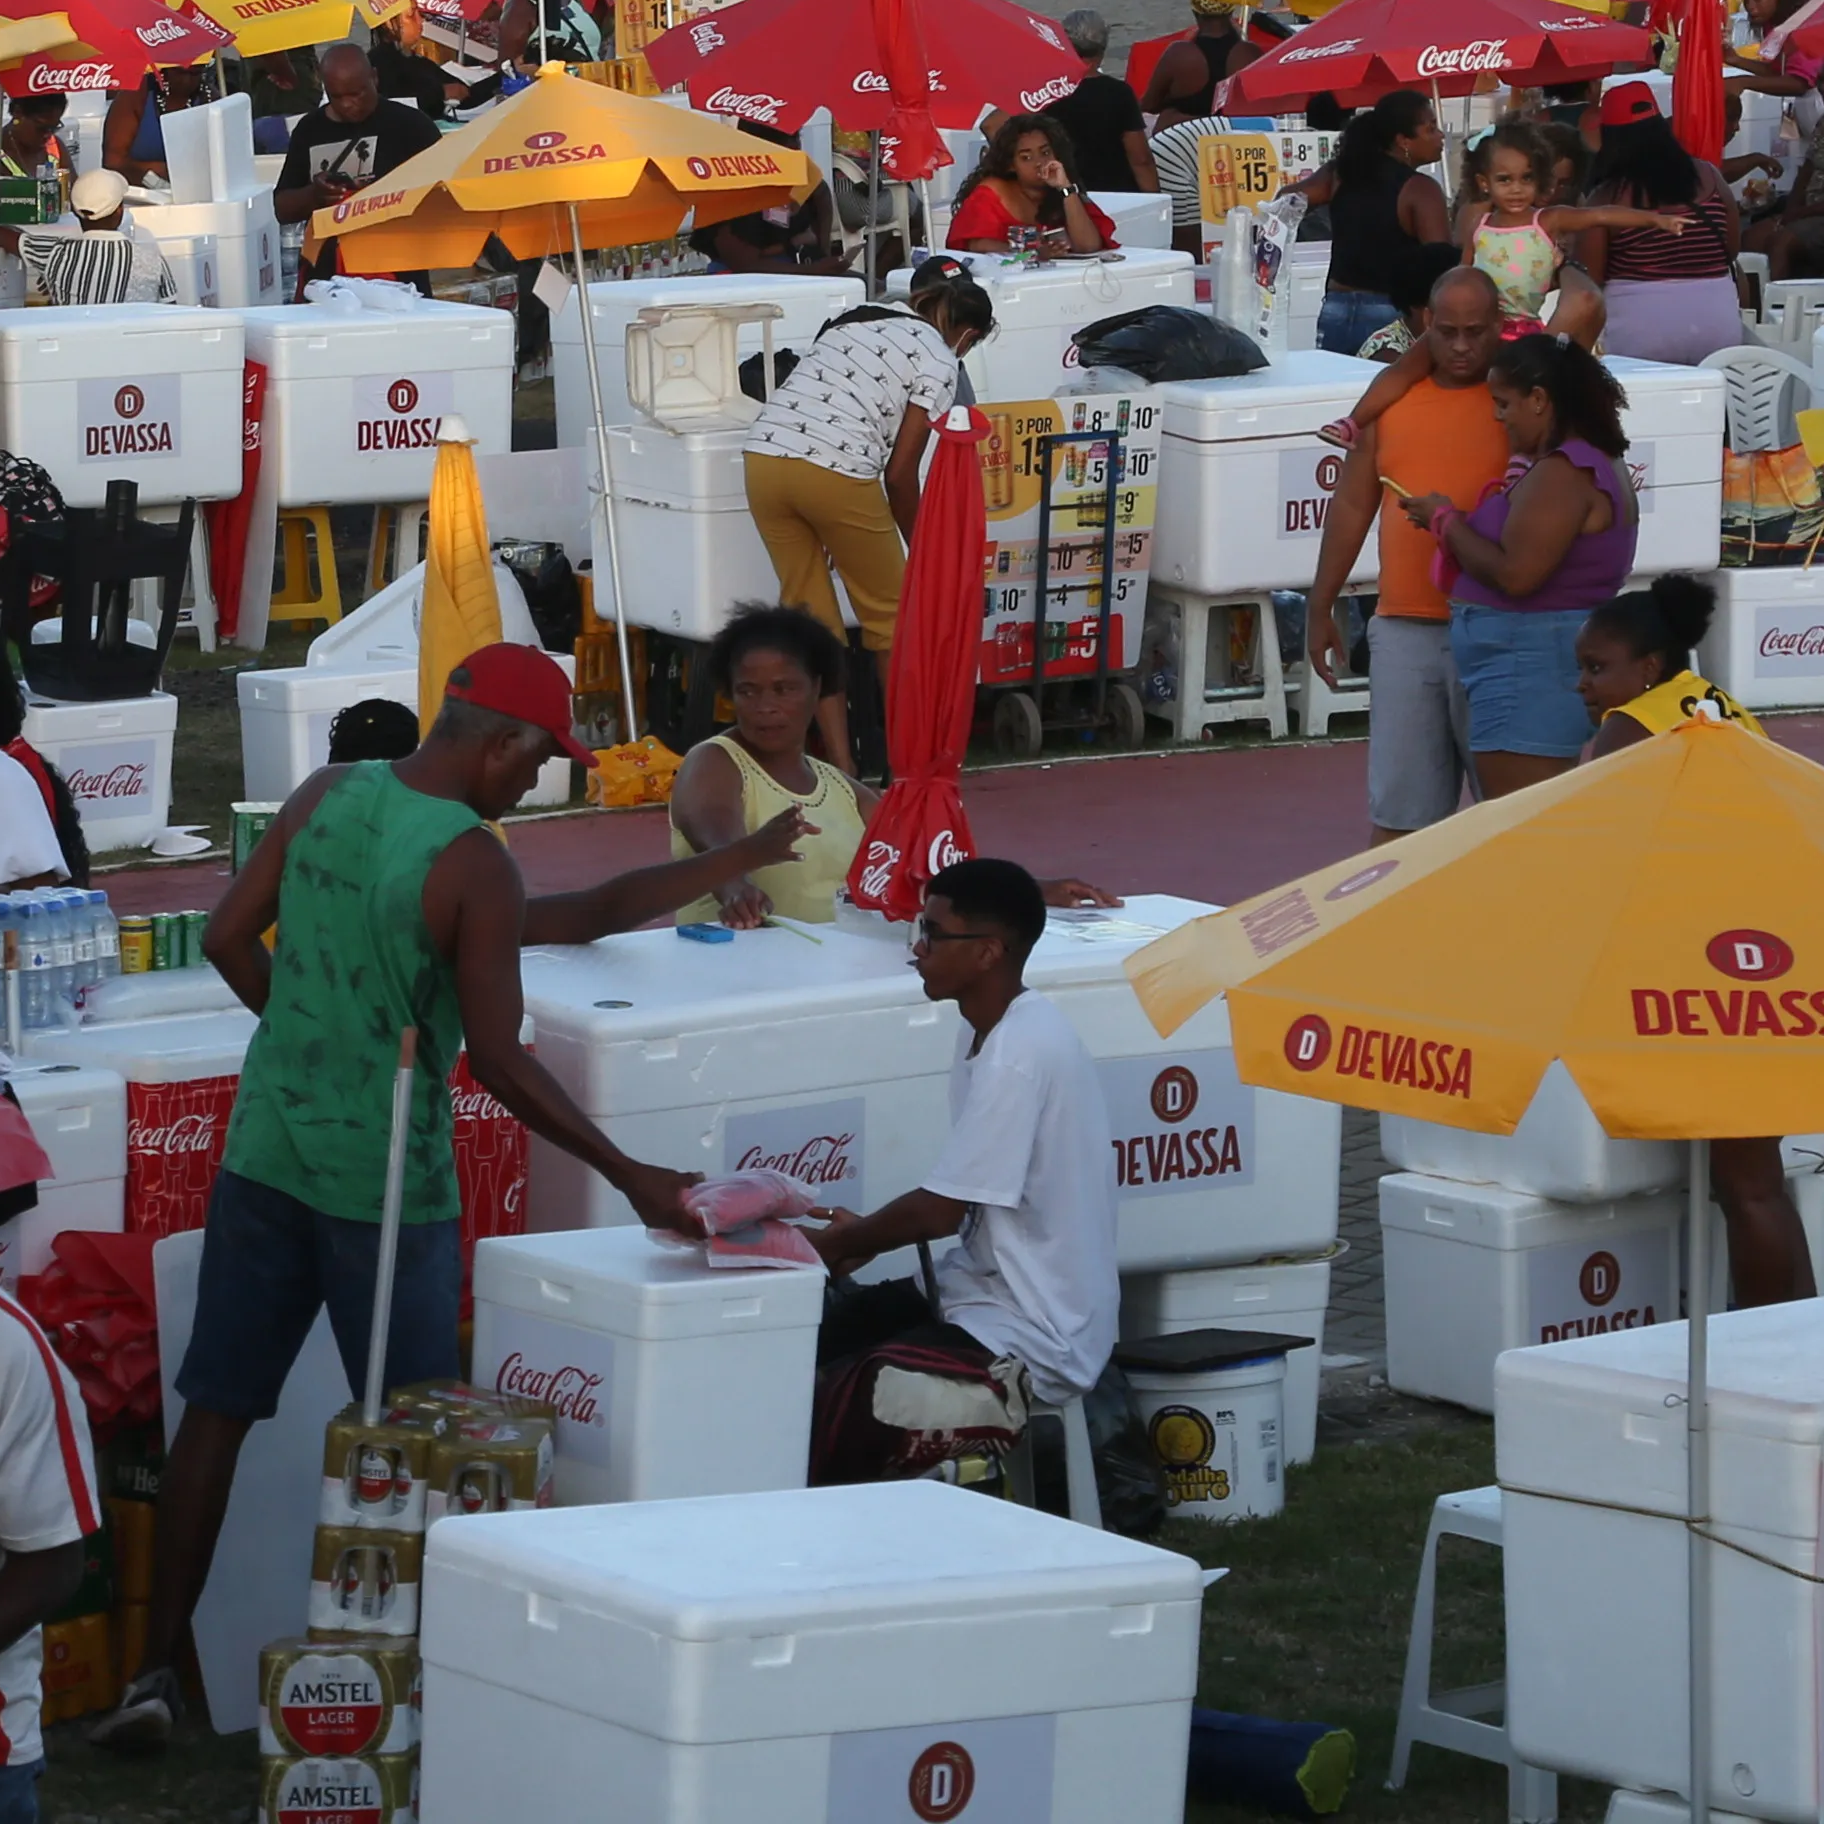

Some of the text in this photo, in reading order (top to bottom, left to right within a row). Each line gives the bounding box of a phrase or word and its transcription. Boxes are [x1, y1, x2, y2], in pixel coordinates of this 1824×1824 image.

[136, 18, 187, 47] Coca-Cola
[1280, 37, 1363, 64] Coca-Cola
[1417, 39, 1507, 76] Coca-Cola
[29, 63, 114, 91] Coca-Cola
[706, 85, 788, 124] Coca-Cola
[1020, 76, 1078, 113] Coca-Cola
[484, 144, 606, 174] DEVASSA
[709, 155, 782, 176] DEVASSA
[1244, 148, 1266, 160] POR
[86, 421, 173, 456] DEVASSA
[357, 417, 440, 452] DEVASS
[1026, 417, 1052, 434] POR
[66, 763, 149, 801] Coca-Cola
[1336, 1023, 1473, 1100] DEVASSA
[496, 1352, 605, 1425] Coca-Cola
[289, 1682, 375, 1705] AMSTEL
[307, 1711, 356, 1725] LAGER
[288, 1784, 375, 1808] AMSTEL
